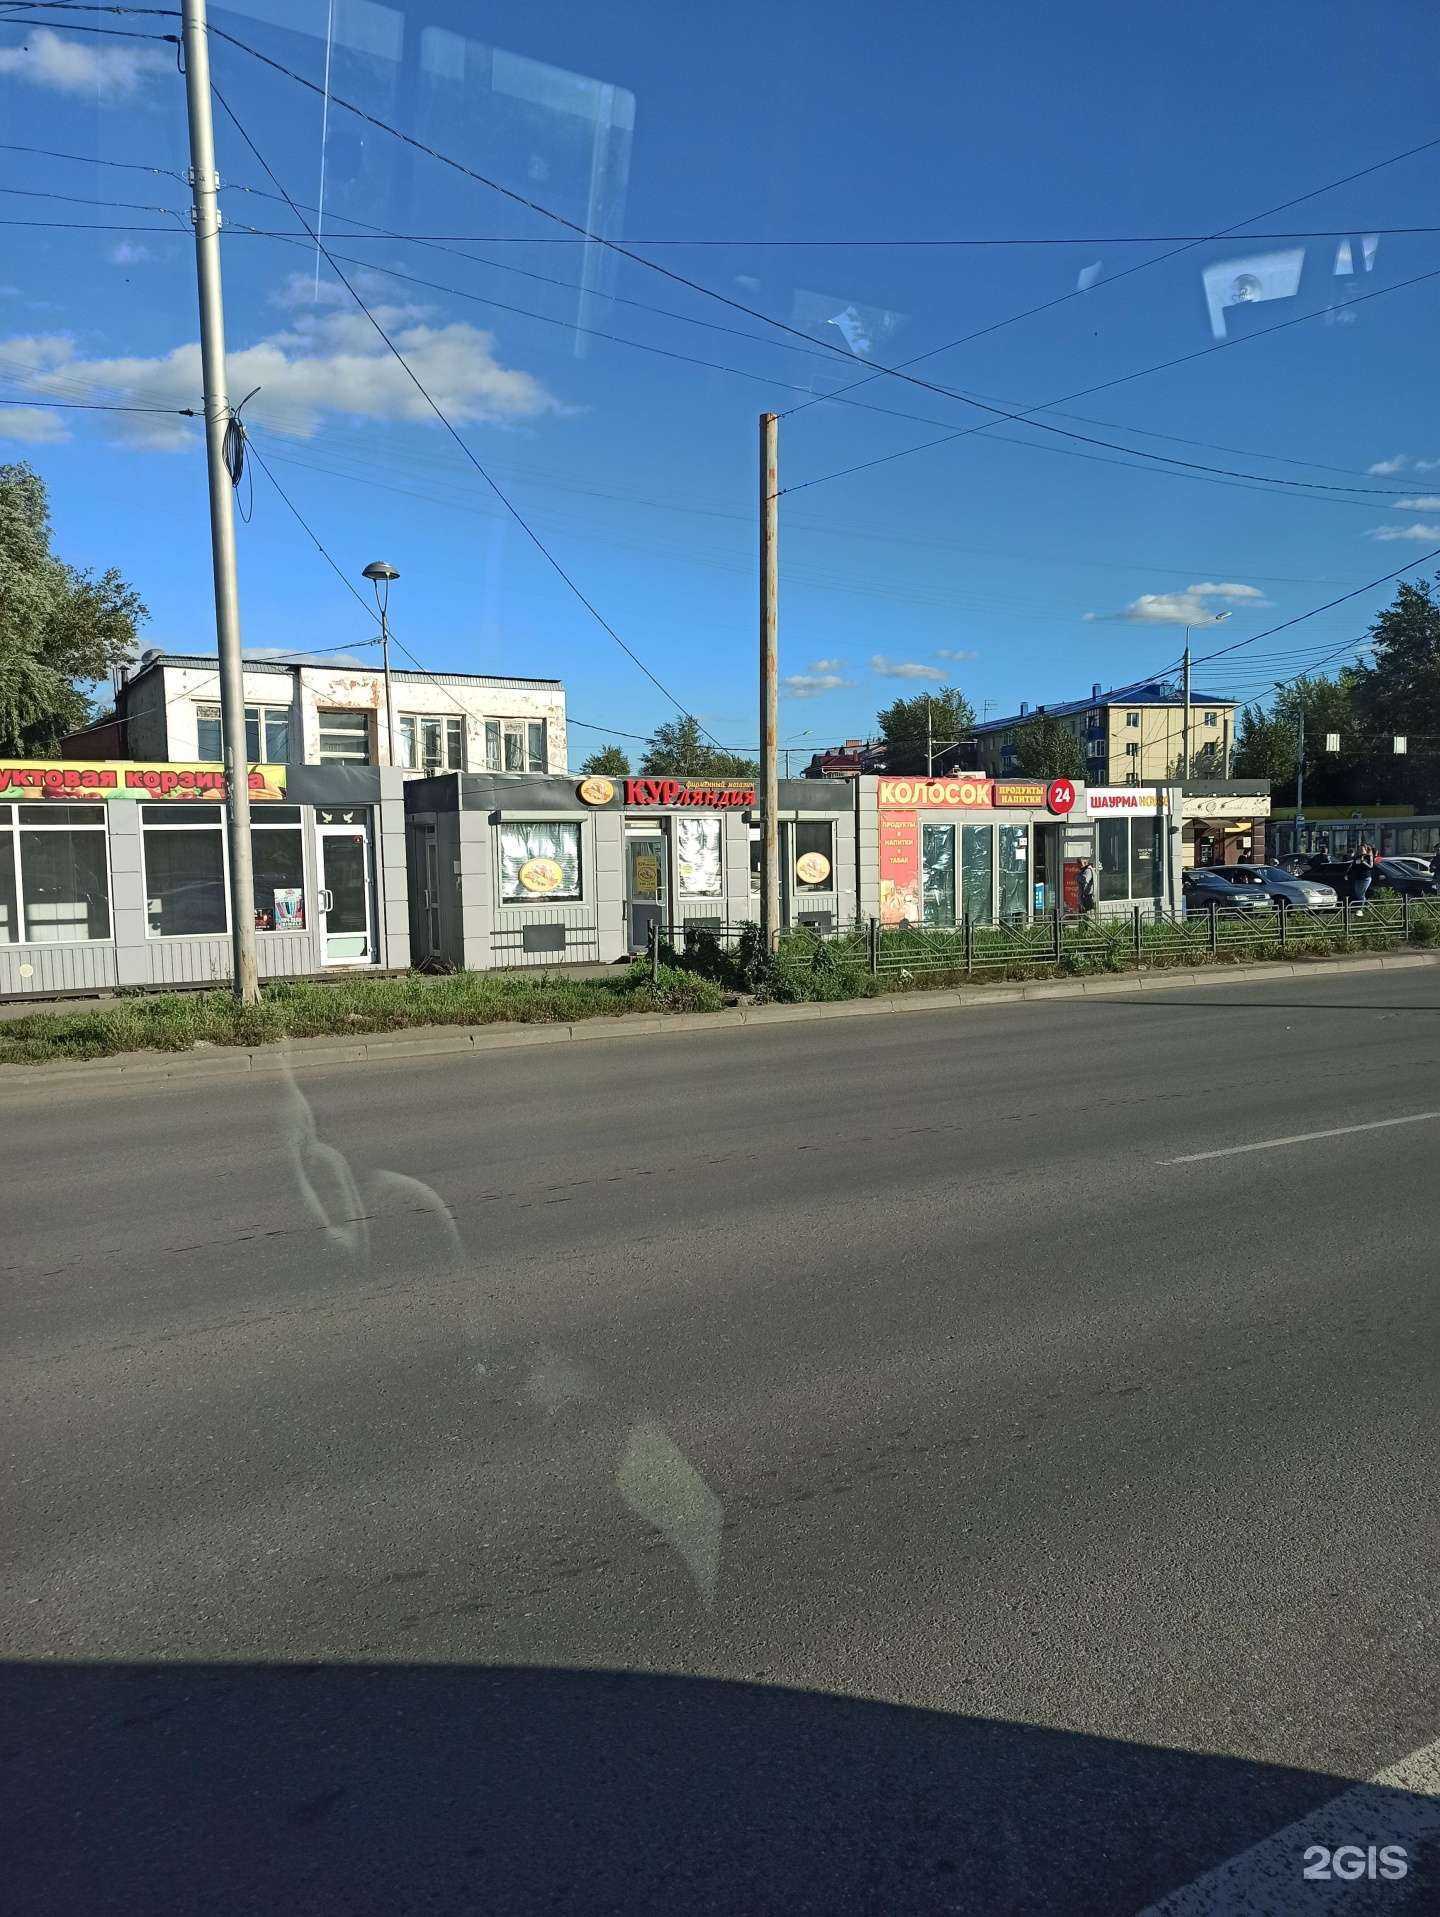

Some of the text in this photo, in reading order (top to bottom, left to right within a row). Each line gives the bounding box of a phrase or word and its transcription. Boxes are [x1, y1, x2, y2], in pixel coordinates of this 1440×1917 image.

[125, 770, 265, 793] корзина
[880, 782, 991, 805] КОЛОСОК
[998, 786, 1044, 795] ПРОДУКТЫ
[1055, 787, 1071, 804] 24
[1001, 795, 1042, 804] НАПИТКИ
[1090, 796, 1138, 808] ШАУРМА
[882, 821, 916, 829] ПРОДУКТЫ
[885, 839, 913, 847] НАПИТКИ
